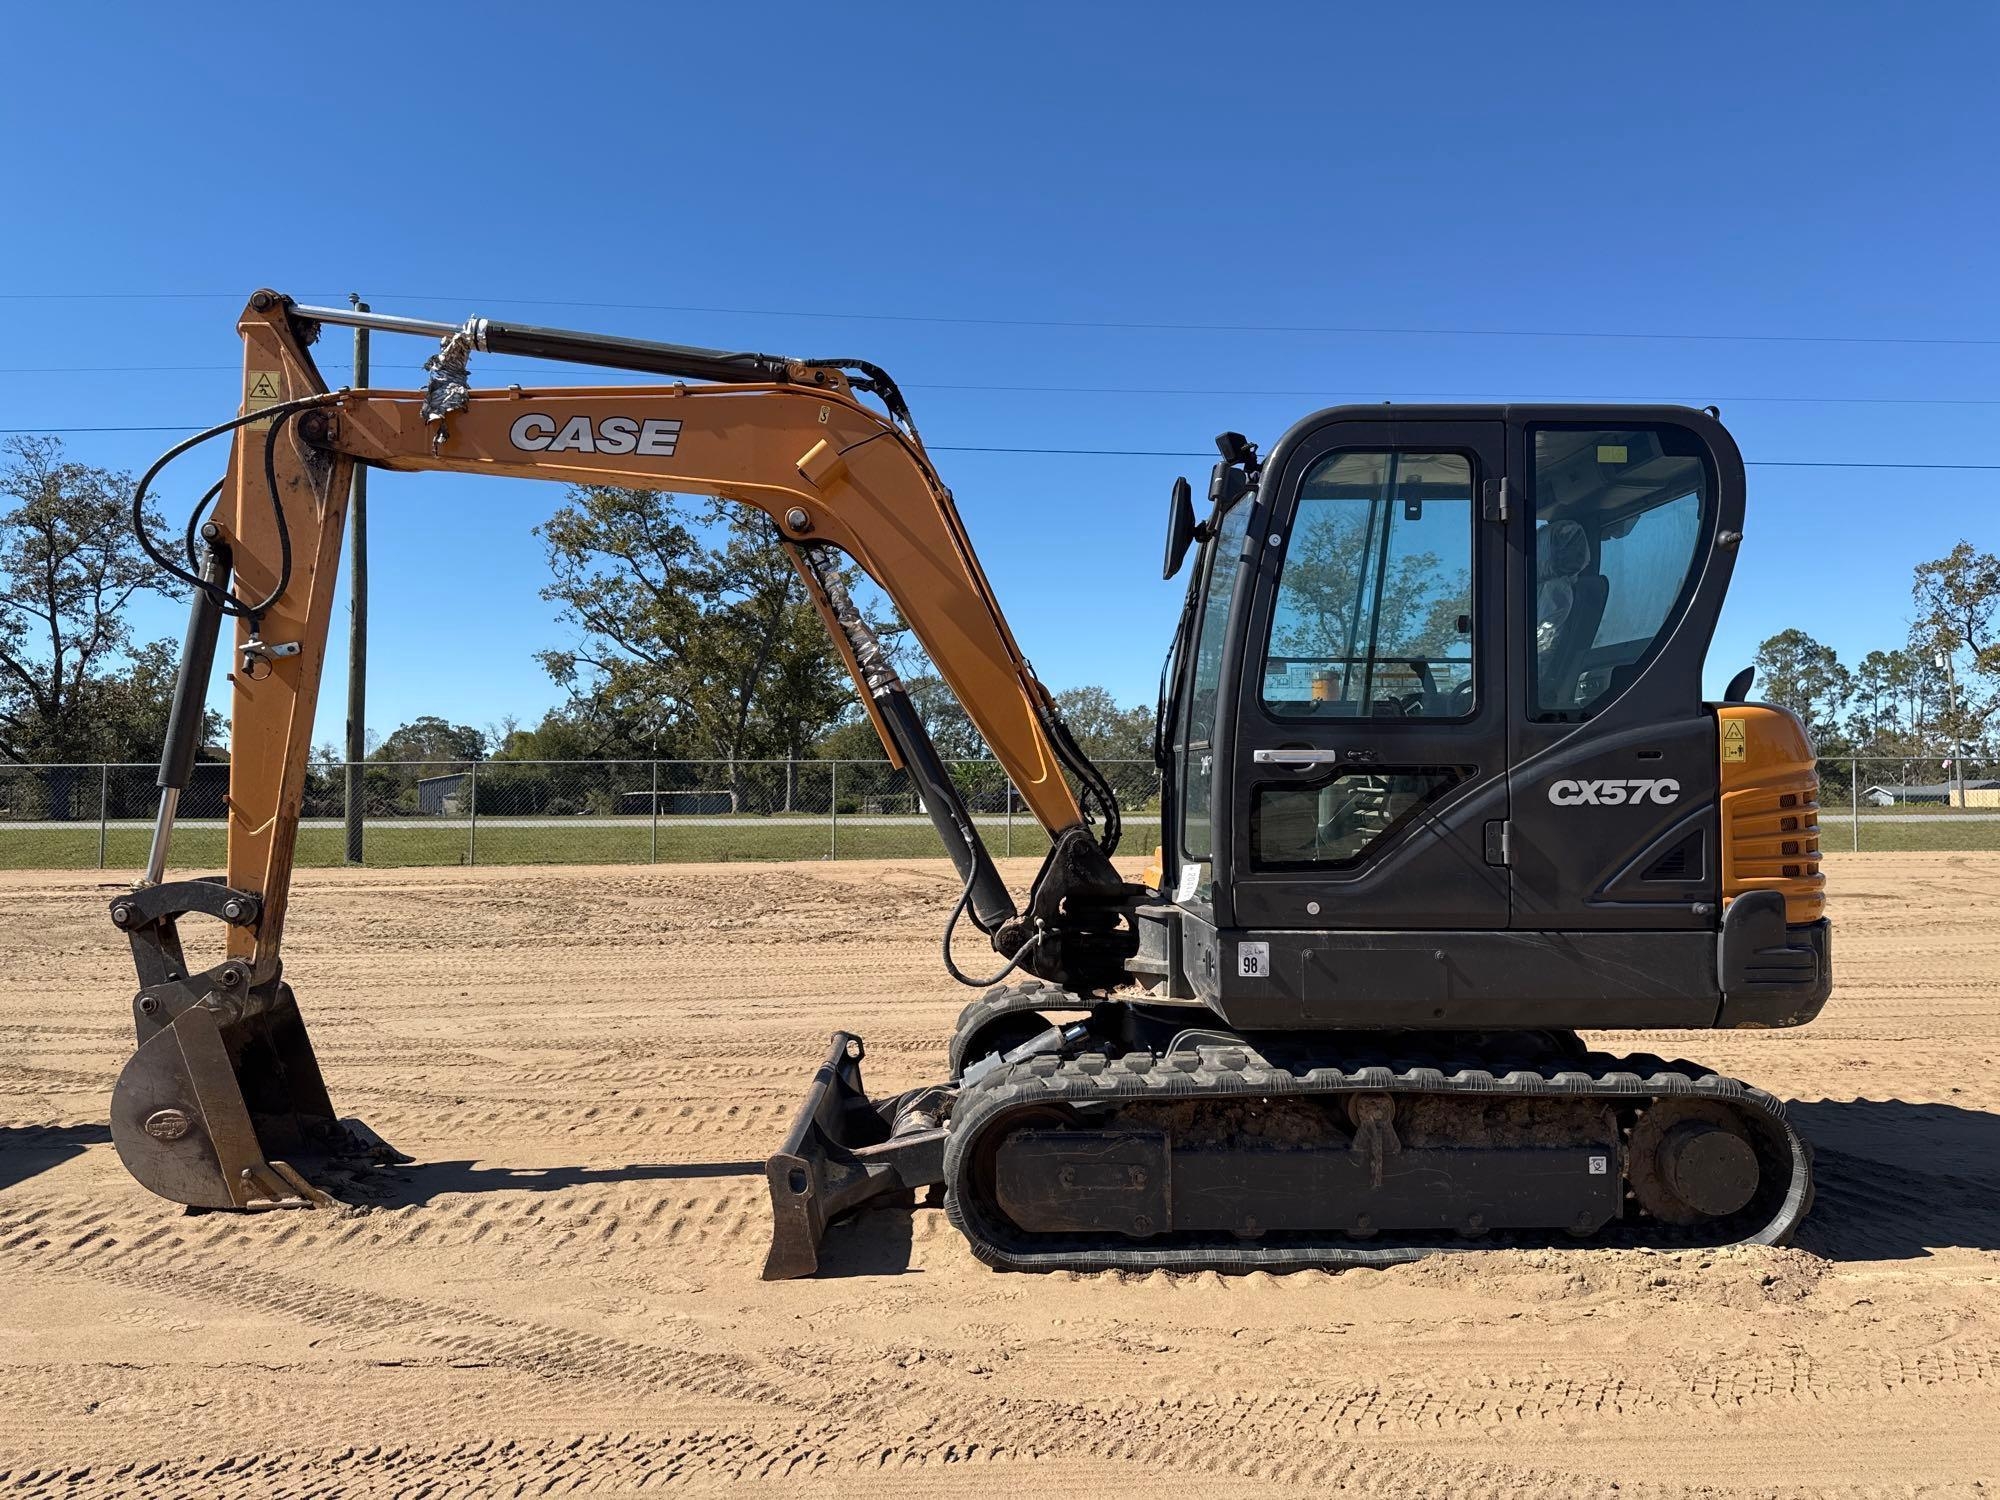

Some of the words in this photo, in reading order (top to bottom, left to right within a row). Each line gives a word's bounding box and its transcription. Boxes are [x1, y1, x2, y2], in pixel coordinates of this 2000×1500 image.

[509, 413, 683, 456] CASE
[1548, 778, 1680, 806] CX57C
[1243, 957, 1258, 974] 98
